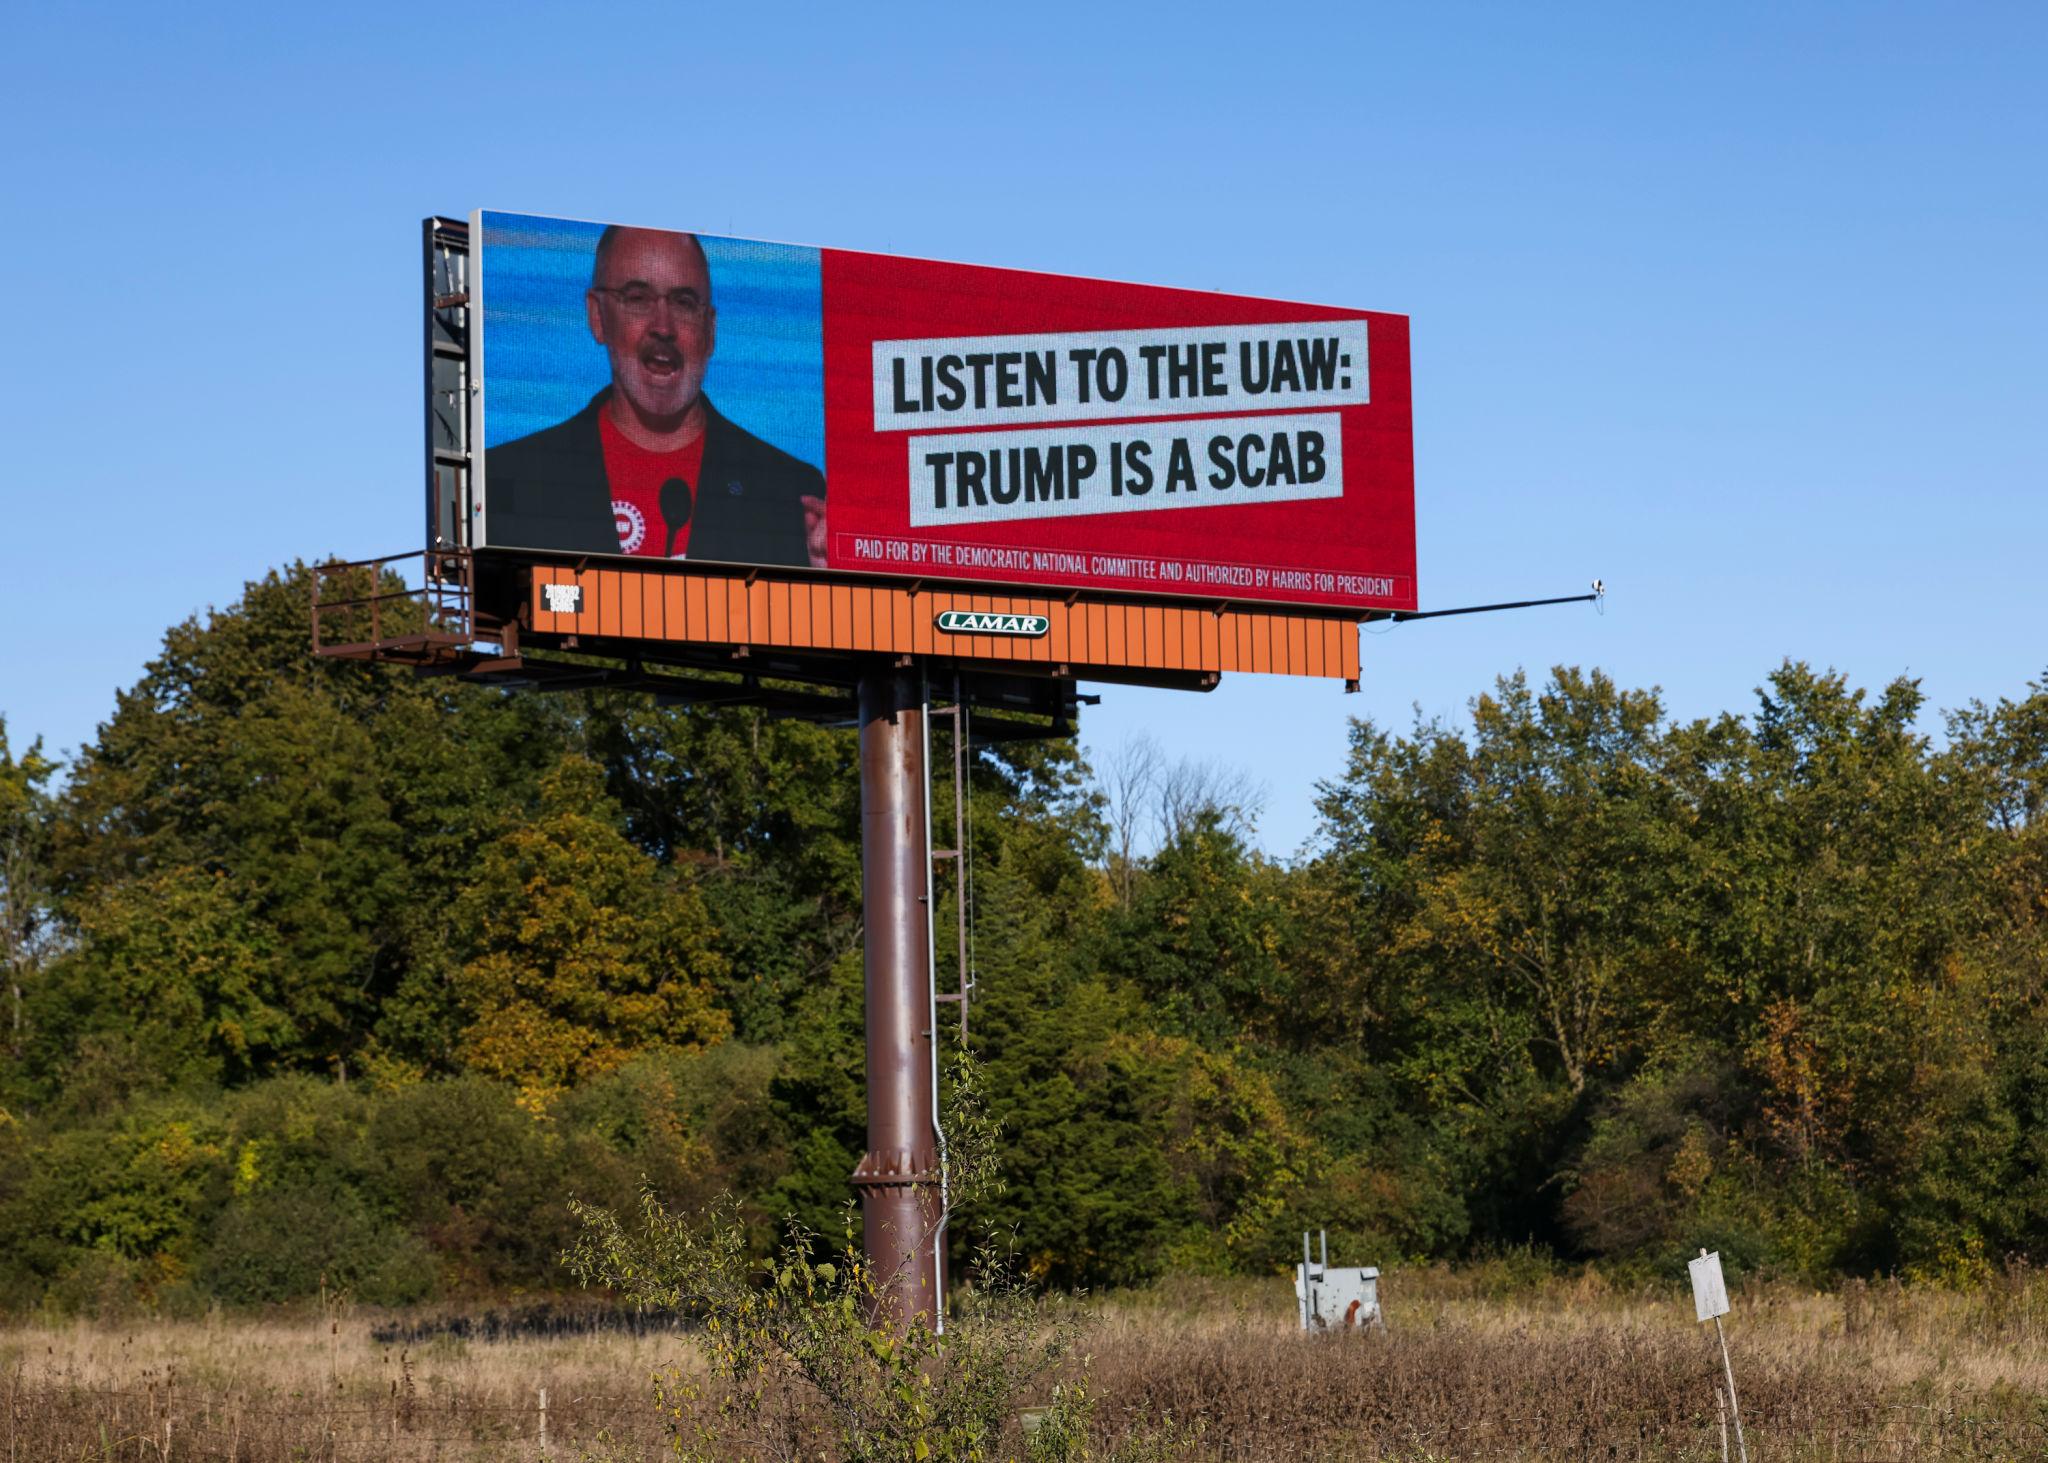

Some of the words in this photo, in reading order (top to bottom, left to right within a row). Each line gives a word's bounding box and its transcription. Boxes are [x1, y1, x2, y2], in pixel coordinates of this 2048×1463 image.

[892, 350, 1057, 414] LISTEN
[1069, 346, 1129, 403] TO
[1139, 342, 1228, 400] THE
[1239, 337, 1351, 395] UAW:
[925, 443, 1097, 509] TRUMP
[1110, 439, 1154, 497] IS
[1165, 437, 1197, 493] A
[1207, 430, 1326, 491] SCAB
[855, 538, 883, 559] PAID
[886, 541, 909, 561] FOR
[912, 543, 928, 562] BY
[930, 544, 952, 565] THE
[955, 546, 1031, 571] DEMOCRATIC
[1033, 551, 1089, 575] NATIONAL
[1092, 556, 1157, 580] COMMITTEE
[1159, 561, 1183, 581] AND
[1185, 563, 1253, 587] AUTHORIZED
[1255, 568, 1270, 587] BY
[1272, 570, 1312, 591] HARRIS
[1314, 573, 1335, 593] FOR
[1337, 575, 1394, 597] PRESIDENT
[948, 613, 1038, 632] LAMAR
